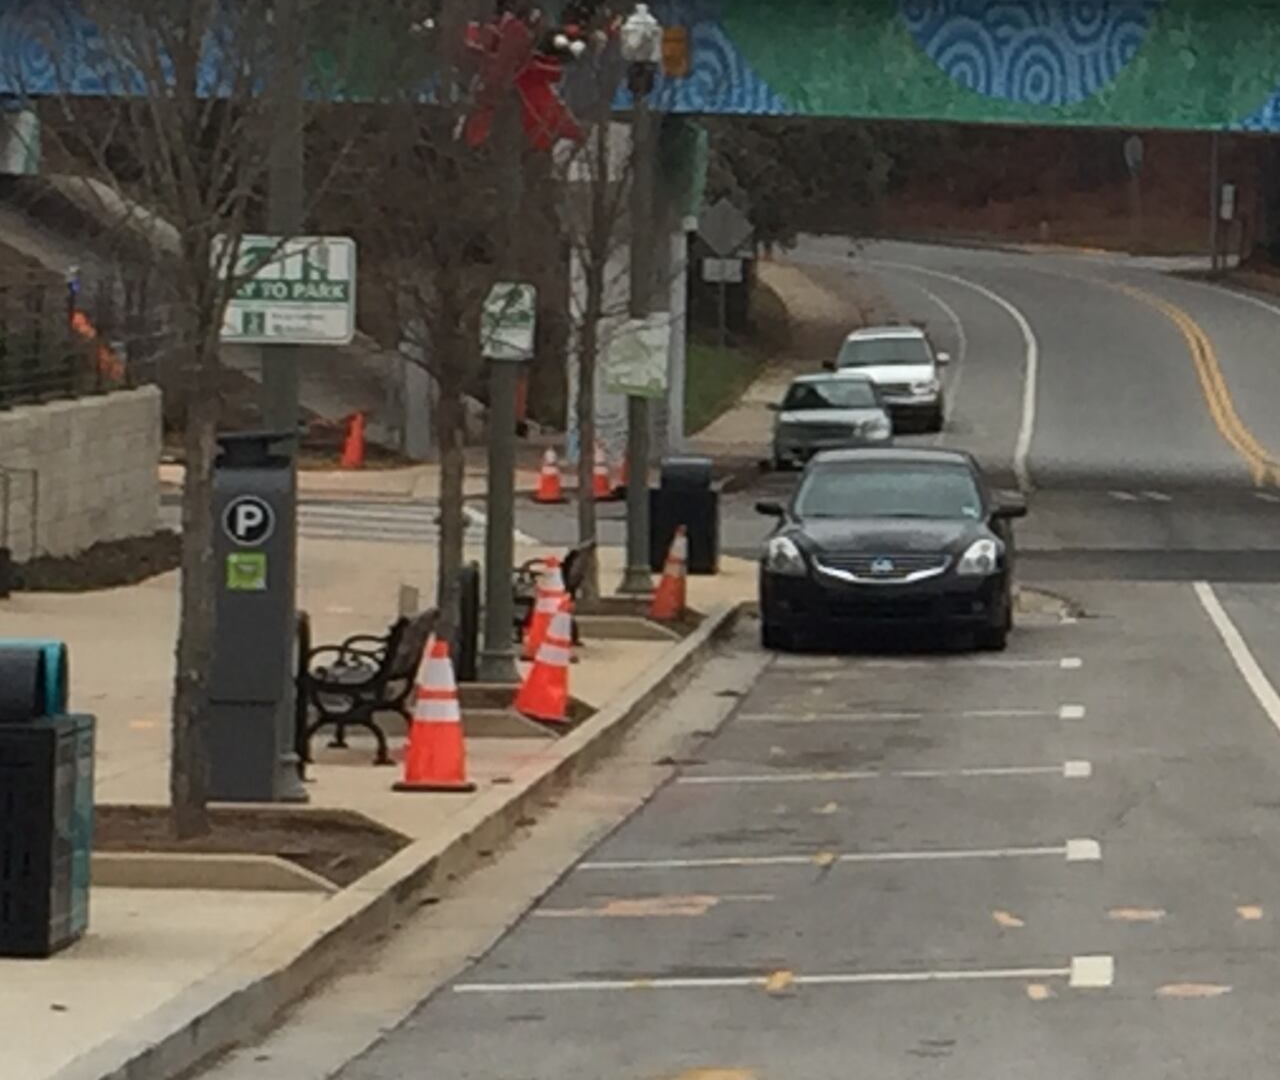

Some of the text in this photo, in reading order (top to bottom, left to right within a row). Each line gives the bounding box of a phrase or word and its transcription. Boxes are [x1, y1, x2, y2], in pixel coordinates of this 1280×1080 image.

[262, 281, 288, 298] TO
[293, 282, 345, 298] PARK
[236, 504, 263, 536] P
